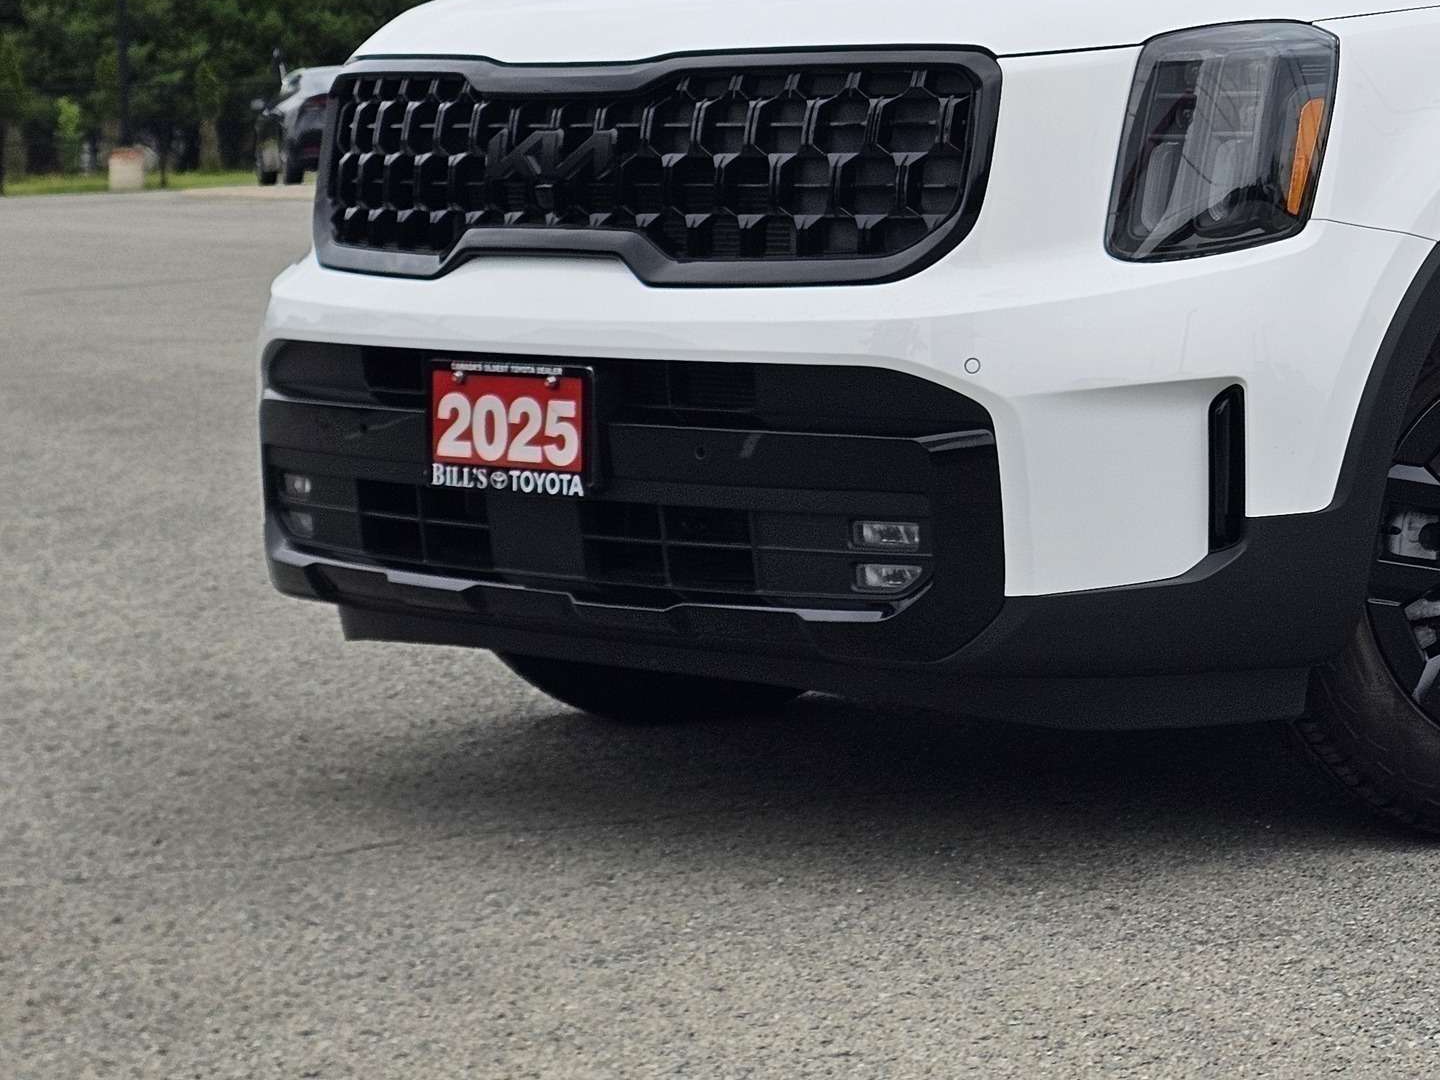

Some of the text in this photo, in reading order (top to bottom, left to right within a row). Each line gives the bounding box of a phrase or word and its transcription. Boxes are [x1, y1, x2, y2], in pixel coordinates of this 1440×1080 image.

[436, 392, 579, 466] 2025
[432, 463, 584, 497] BILL'S TOYOTA
